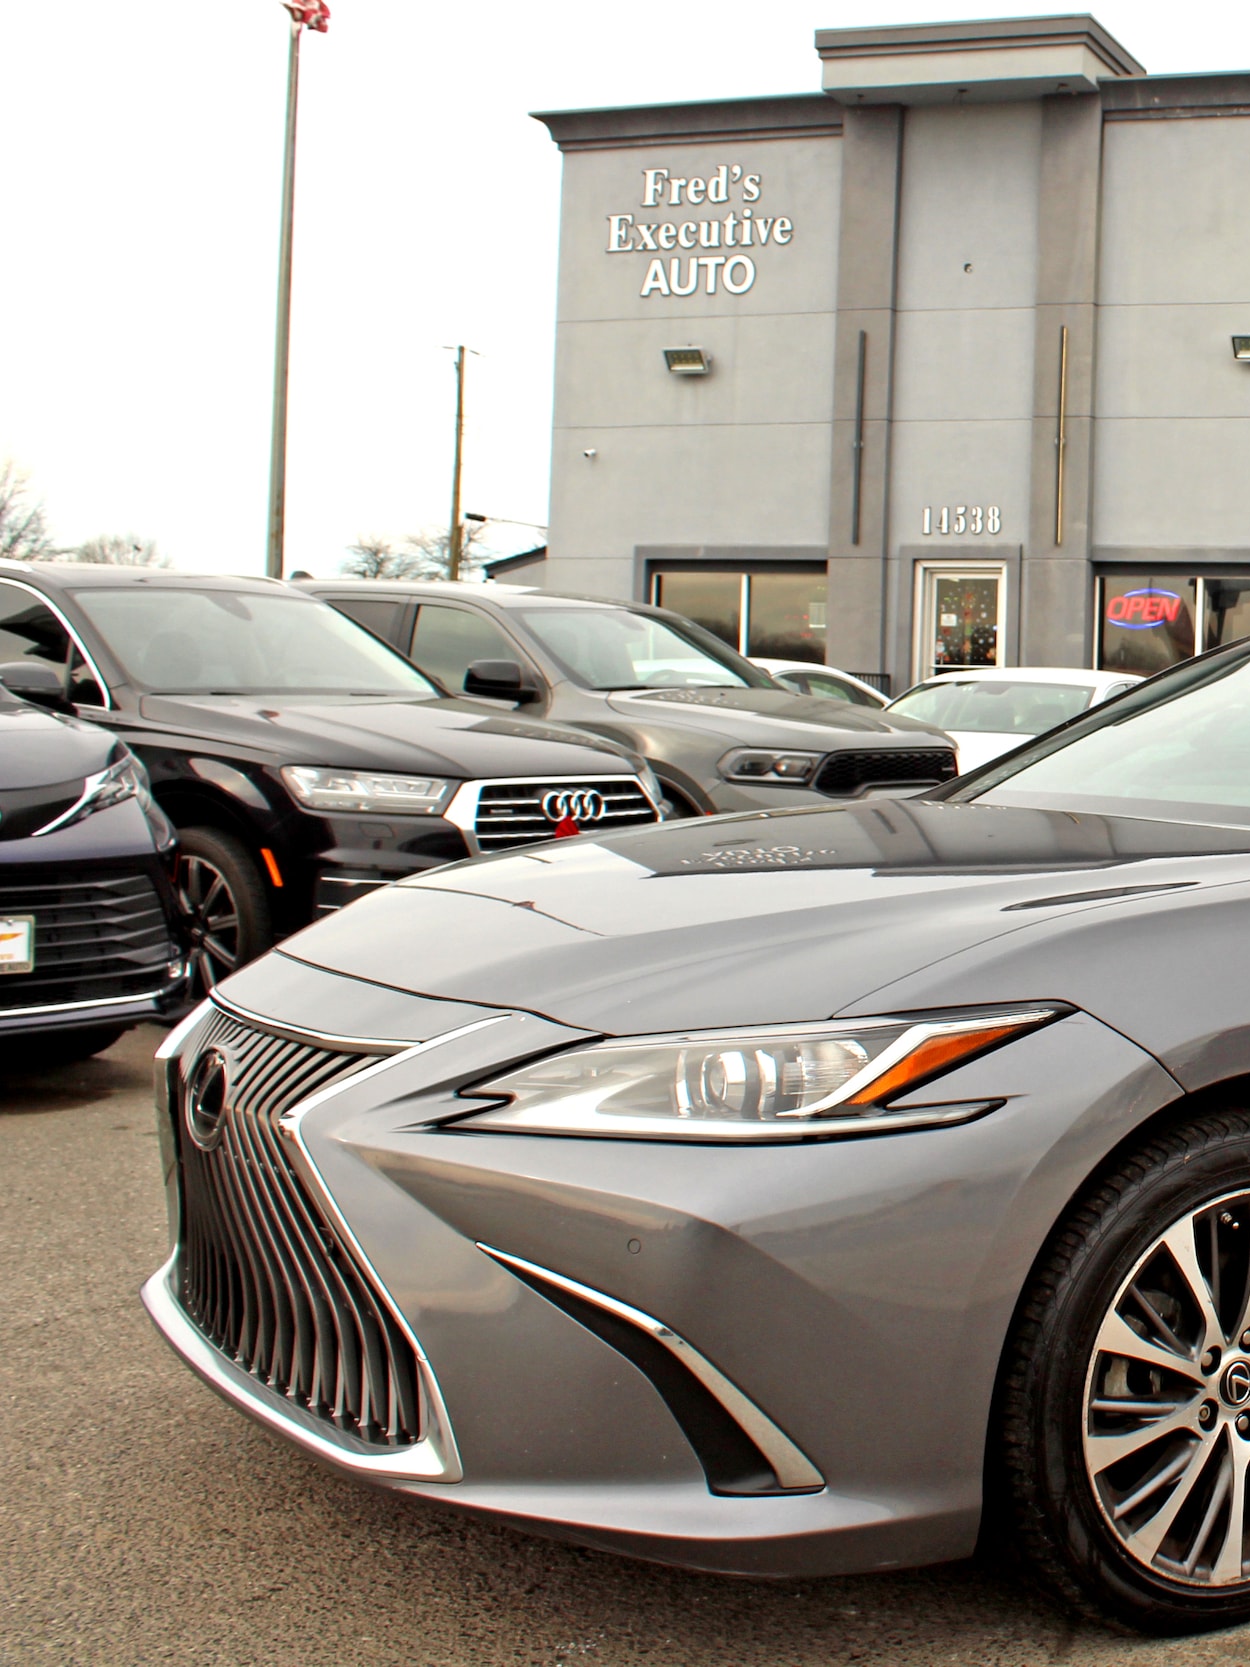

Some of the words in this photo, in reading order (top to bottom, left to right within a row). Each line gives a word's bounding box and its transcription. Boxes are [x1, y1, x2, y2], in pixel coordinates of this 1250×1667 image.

[640, 164, 762, 207] Fred's
[606, 208, 793, 253] Executive
[640, 254, 756, 297] AUTO
[922, 505, 1001, 535] 14538
[1106, 595, 1181, 622] OPEN
